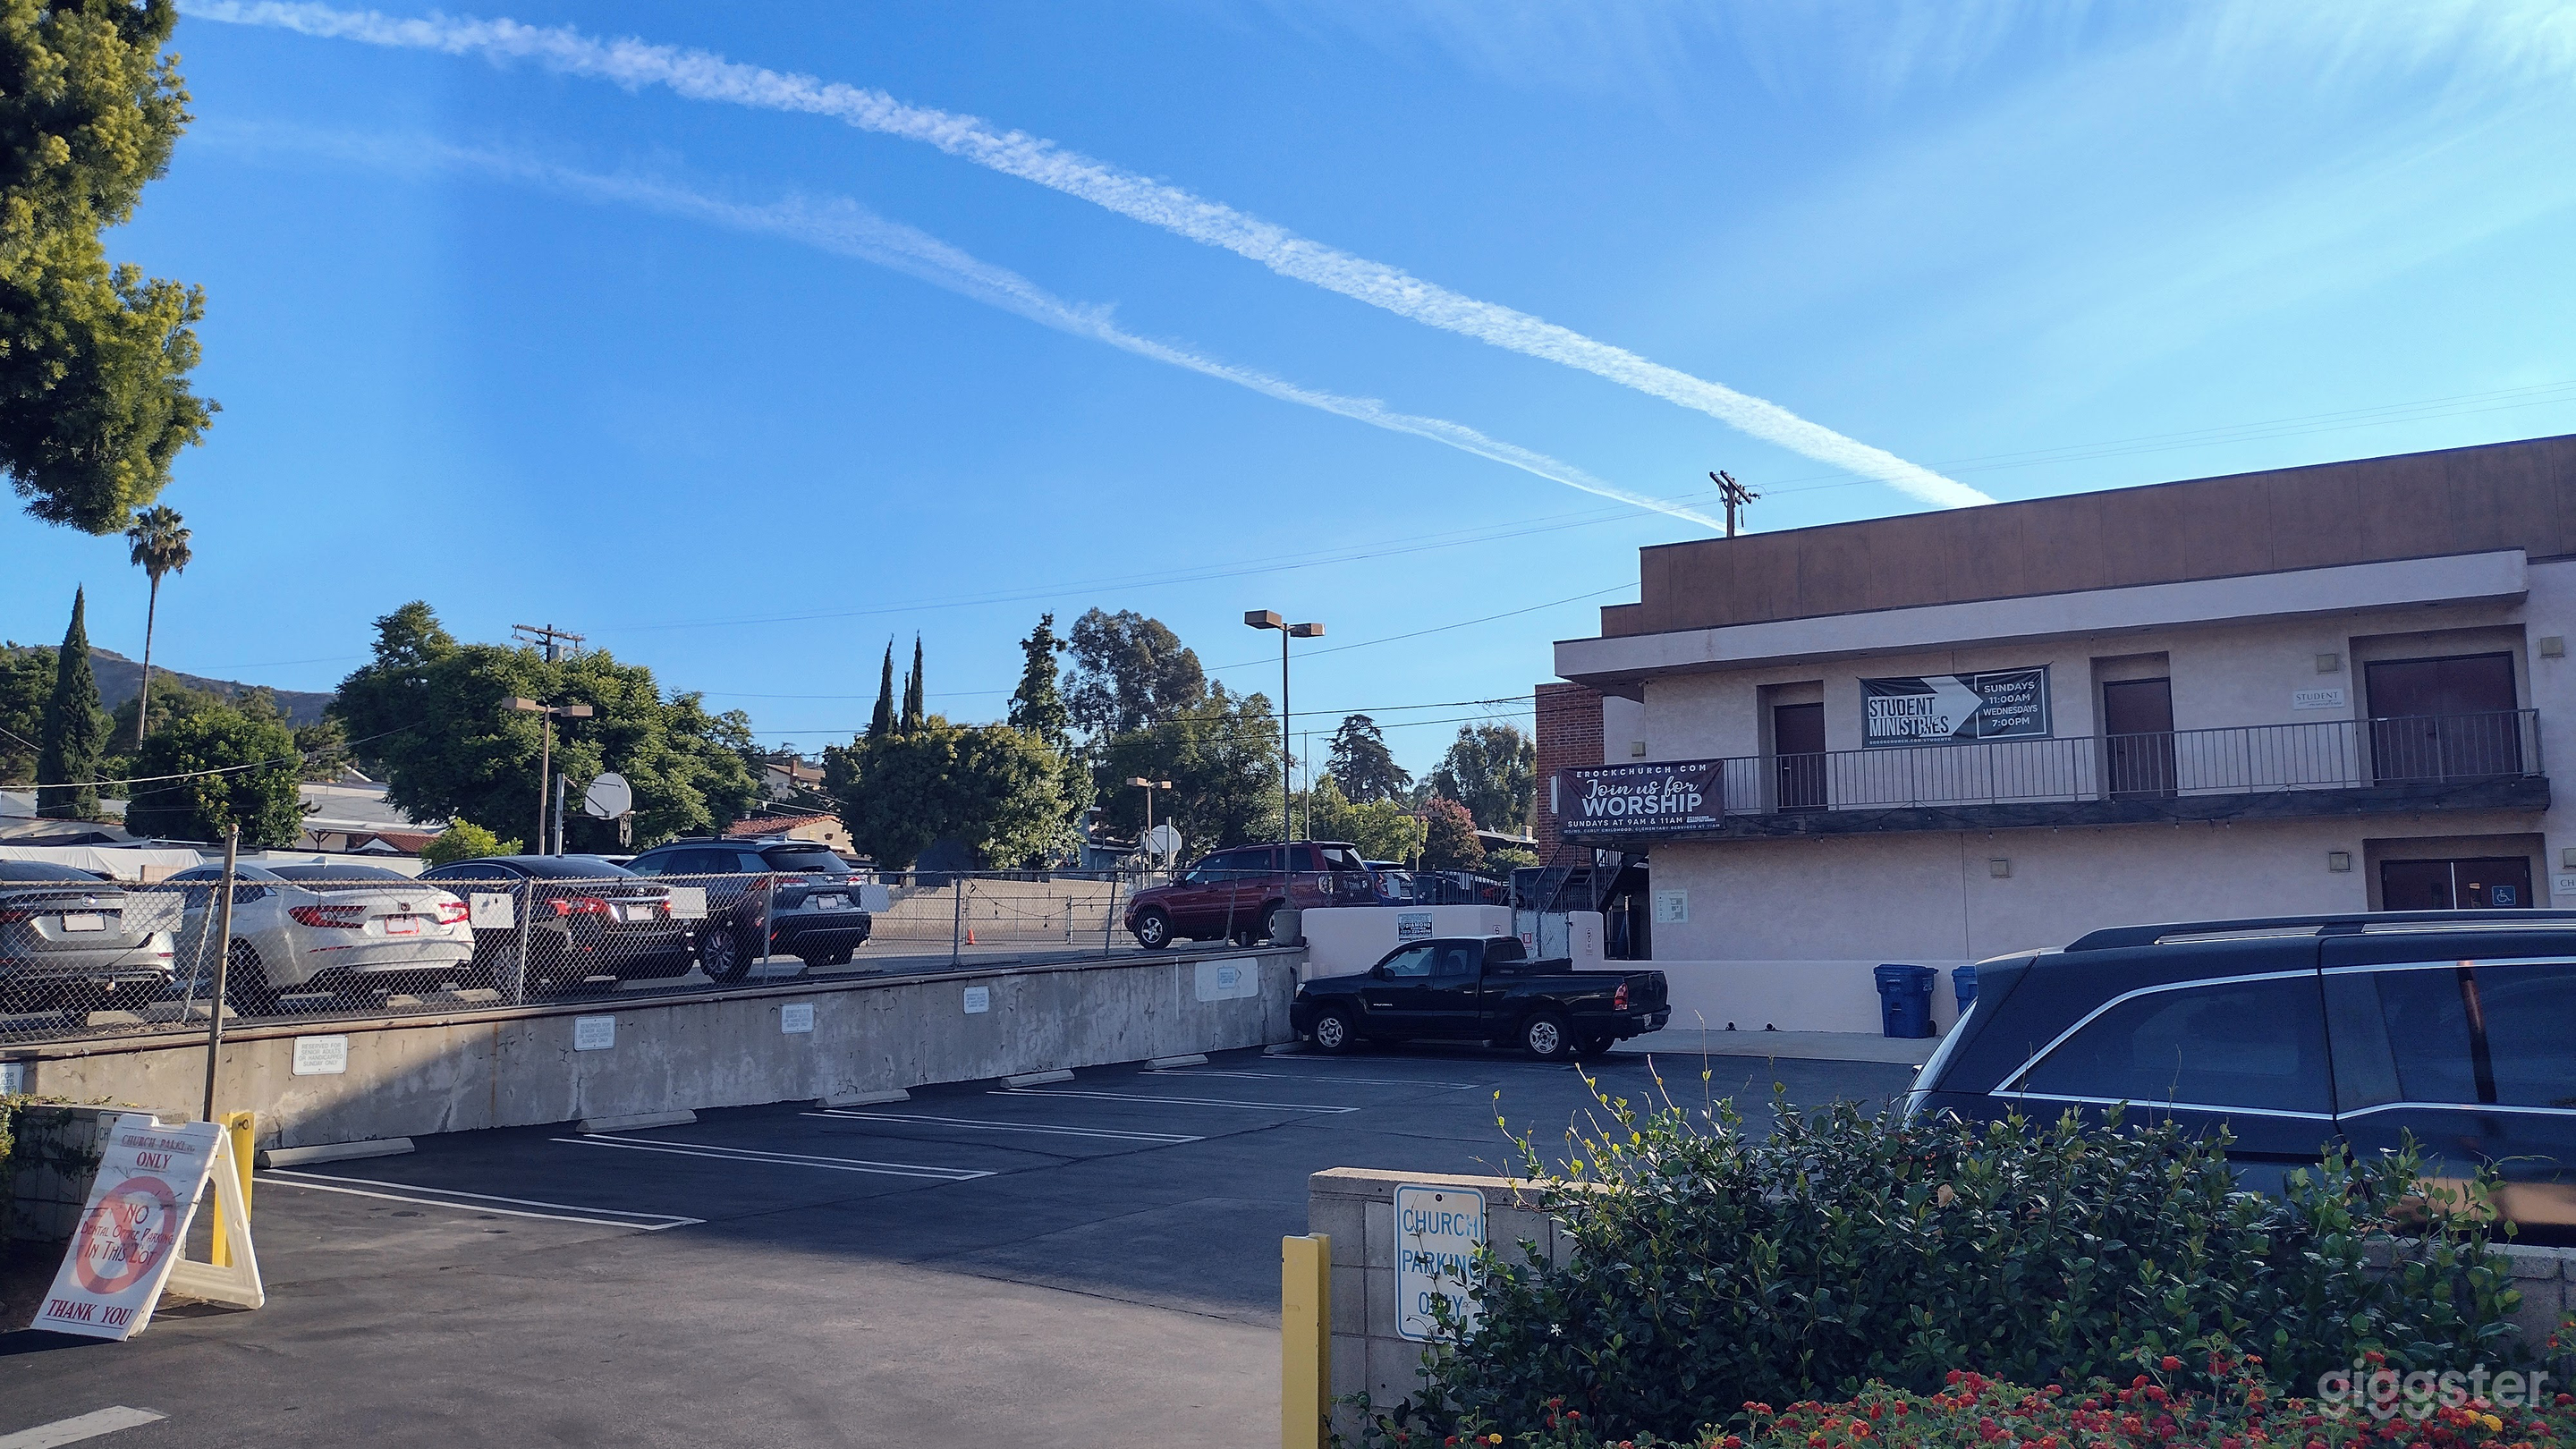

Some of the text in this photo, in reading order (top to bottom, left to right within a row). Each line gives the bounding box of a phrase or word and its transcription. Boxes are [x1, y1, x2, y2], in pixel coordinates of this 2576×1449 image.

[1984, 682, 2035, 693] SUNDAYS
[2296, 691, 2338, 700] STUDENT
[1869, 697, 1936, 717] STUDENT
[1989, 693, 2030, 704] 11:00AM
[1983, 705, 2038, 716] WEDNESDAYS
[1869, 716, 1949, 737] MINISTRIES
[1992, 717, 2030, 727] 7:00PM
[1585, 775, 1699, 799] Join us for
[1582, 793, 1703, 817] WORSHIP
[1568, 819, 1609, 827] SUNDAYS
[1627, 818, 1647, 826] 9AM
[1660, 817, 1682, 825] 11AM
[122, 1134, 157, 1148] CHURCH
[136, 1151, 173, 1169] ONLY
[123, 1204, 149, 1224] NO
[1402, 1208, 1478, 1238] CHURCH
[84, 1238, 157, 1266] IN THIS LOT
[46, 1299, 133, 1326] THANK YOU
